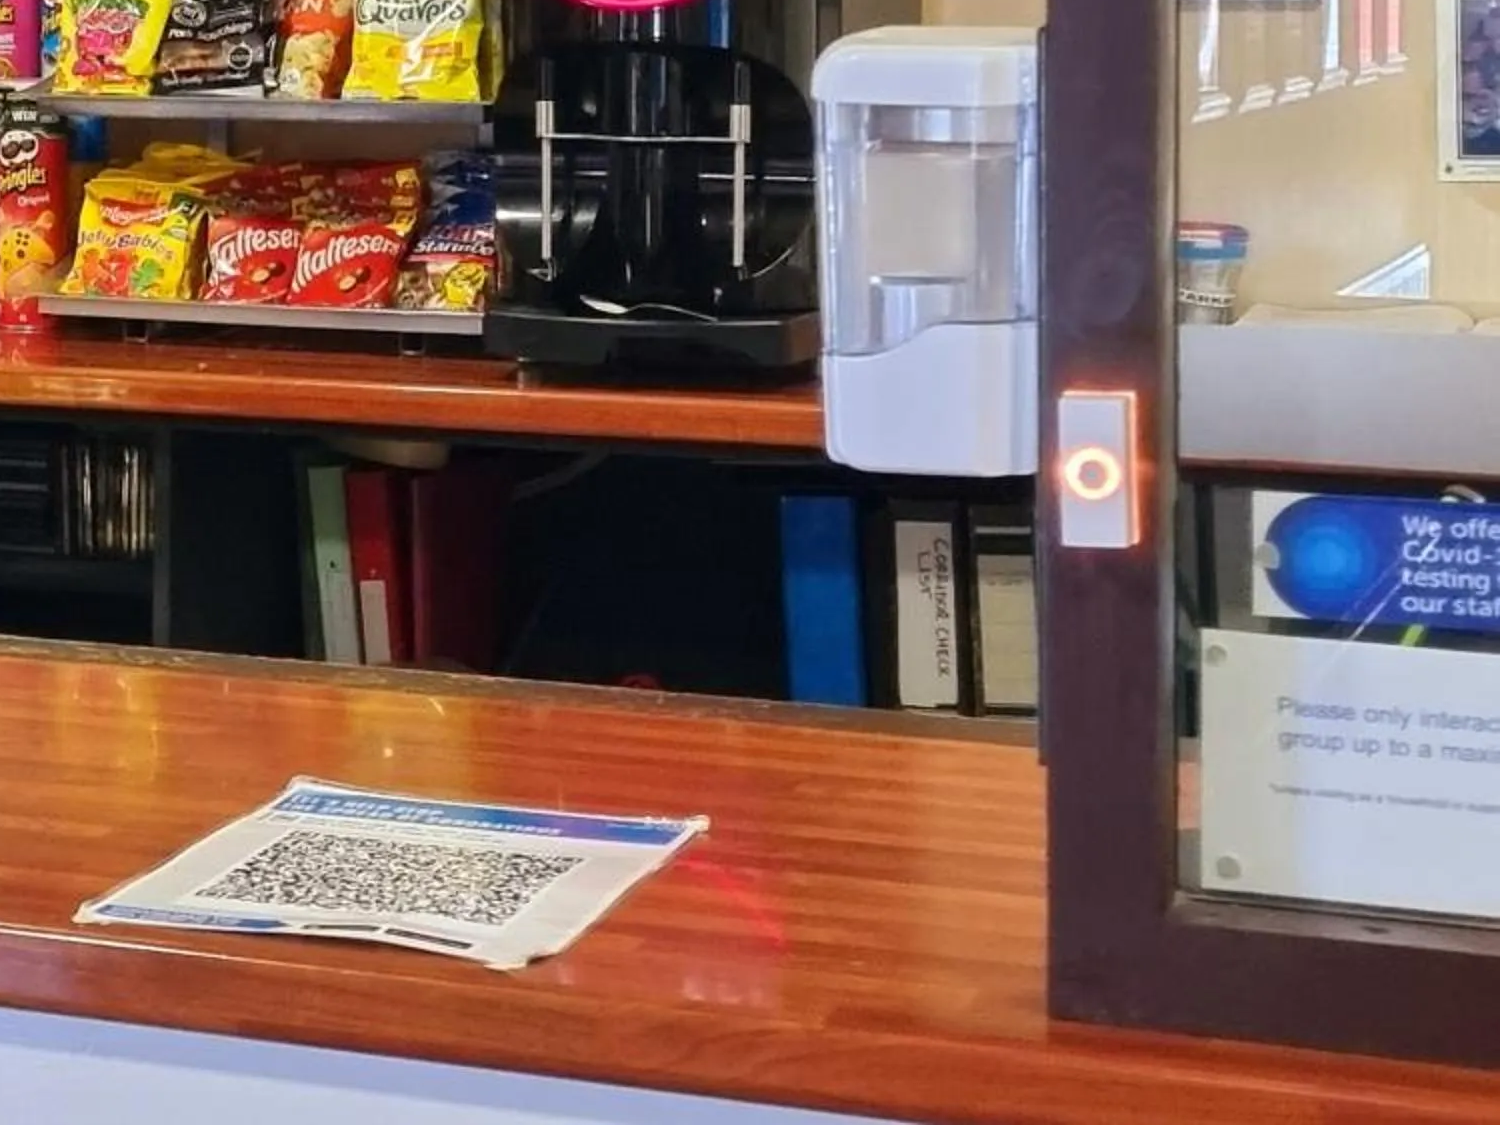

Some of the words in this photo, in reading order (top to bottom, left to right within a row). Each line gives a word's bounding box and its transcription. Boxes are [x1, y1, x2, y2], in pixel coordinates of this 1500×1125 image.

[210, 227, 300, 276] Malteser
[292, 234, 401, 293] Maltesers
[1401, 516, 1442, 537] We
[917, 550, 933, 600] LIST
[1401, 566, 1491, 595] testing
[1400, 597, 1447, 613] our
[934, 627, 951, 678] CHECK
[1276, 696, 1356, 722] Please
[1363, 706, 1413, 730] only
[1277, 731, 1345, 755] group
[1352, 737, 1381, 758] up
[1389, 738, 1410, 757] to
[1417, 743, 1432, 759] a
